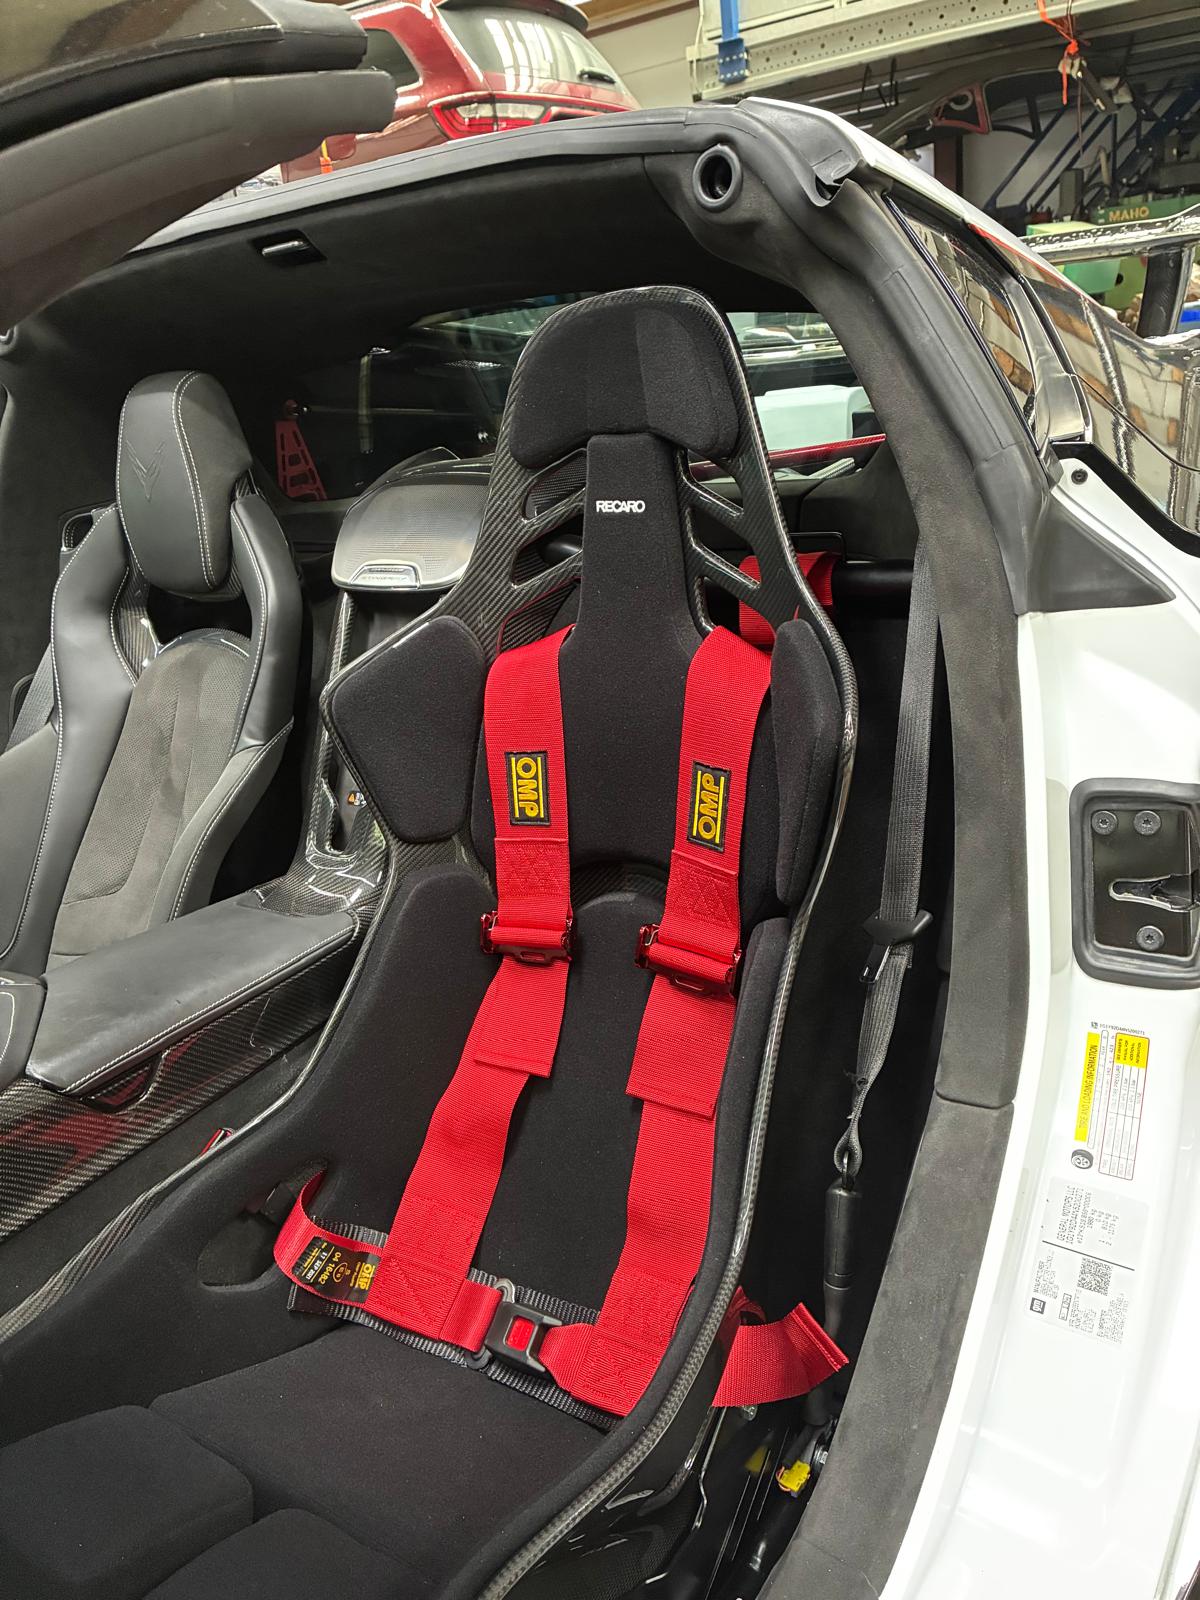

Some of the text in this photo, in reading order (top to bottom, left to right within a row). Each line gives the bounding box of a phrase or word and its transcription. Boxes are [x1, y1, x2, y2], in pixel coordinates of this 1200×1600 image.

[1109, 206, 1150, 221] MAHO
[596, 500, 646, 513] RECARO
[516, 757, 539, 818] OMP
[698, 773, 720, 840] OMP
[1085, 1044, 1097, 1079] INFORMATION
[1082, 1080, 1092, 1103] LOADING
[1080, 1103, 1089, 1115] AND
[1061, 1195, 1073, 1217] MOTORS
[1056, 1216, 1068, 1241] GENERAL
[332, 1252, 342, 1262] 04
[318, 1264, 336, 1284] 16482
[358, 1264, 372, 1290] OMP
